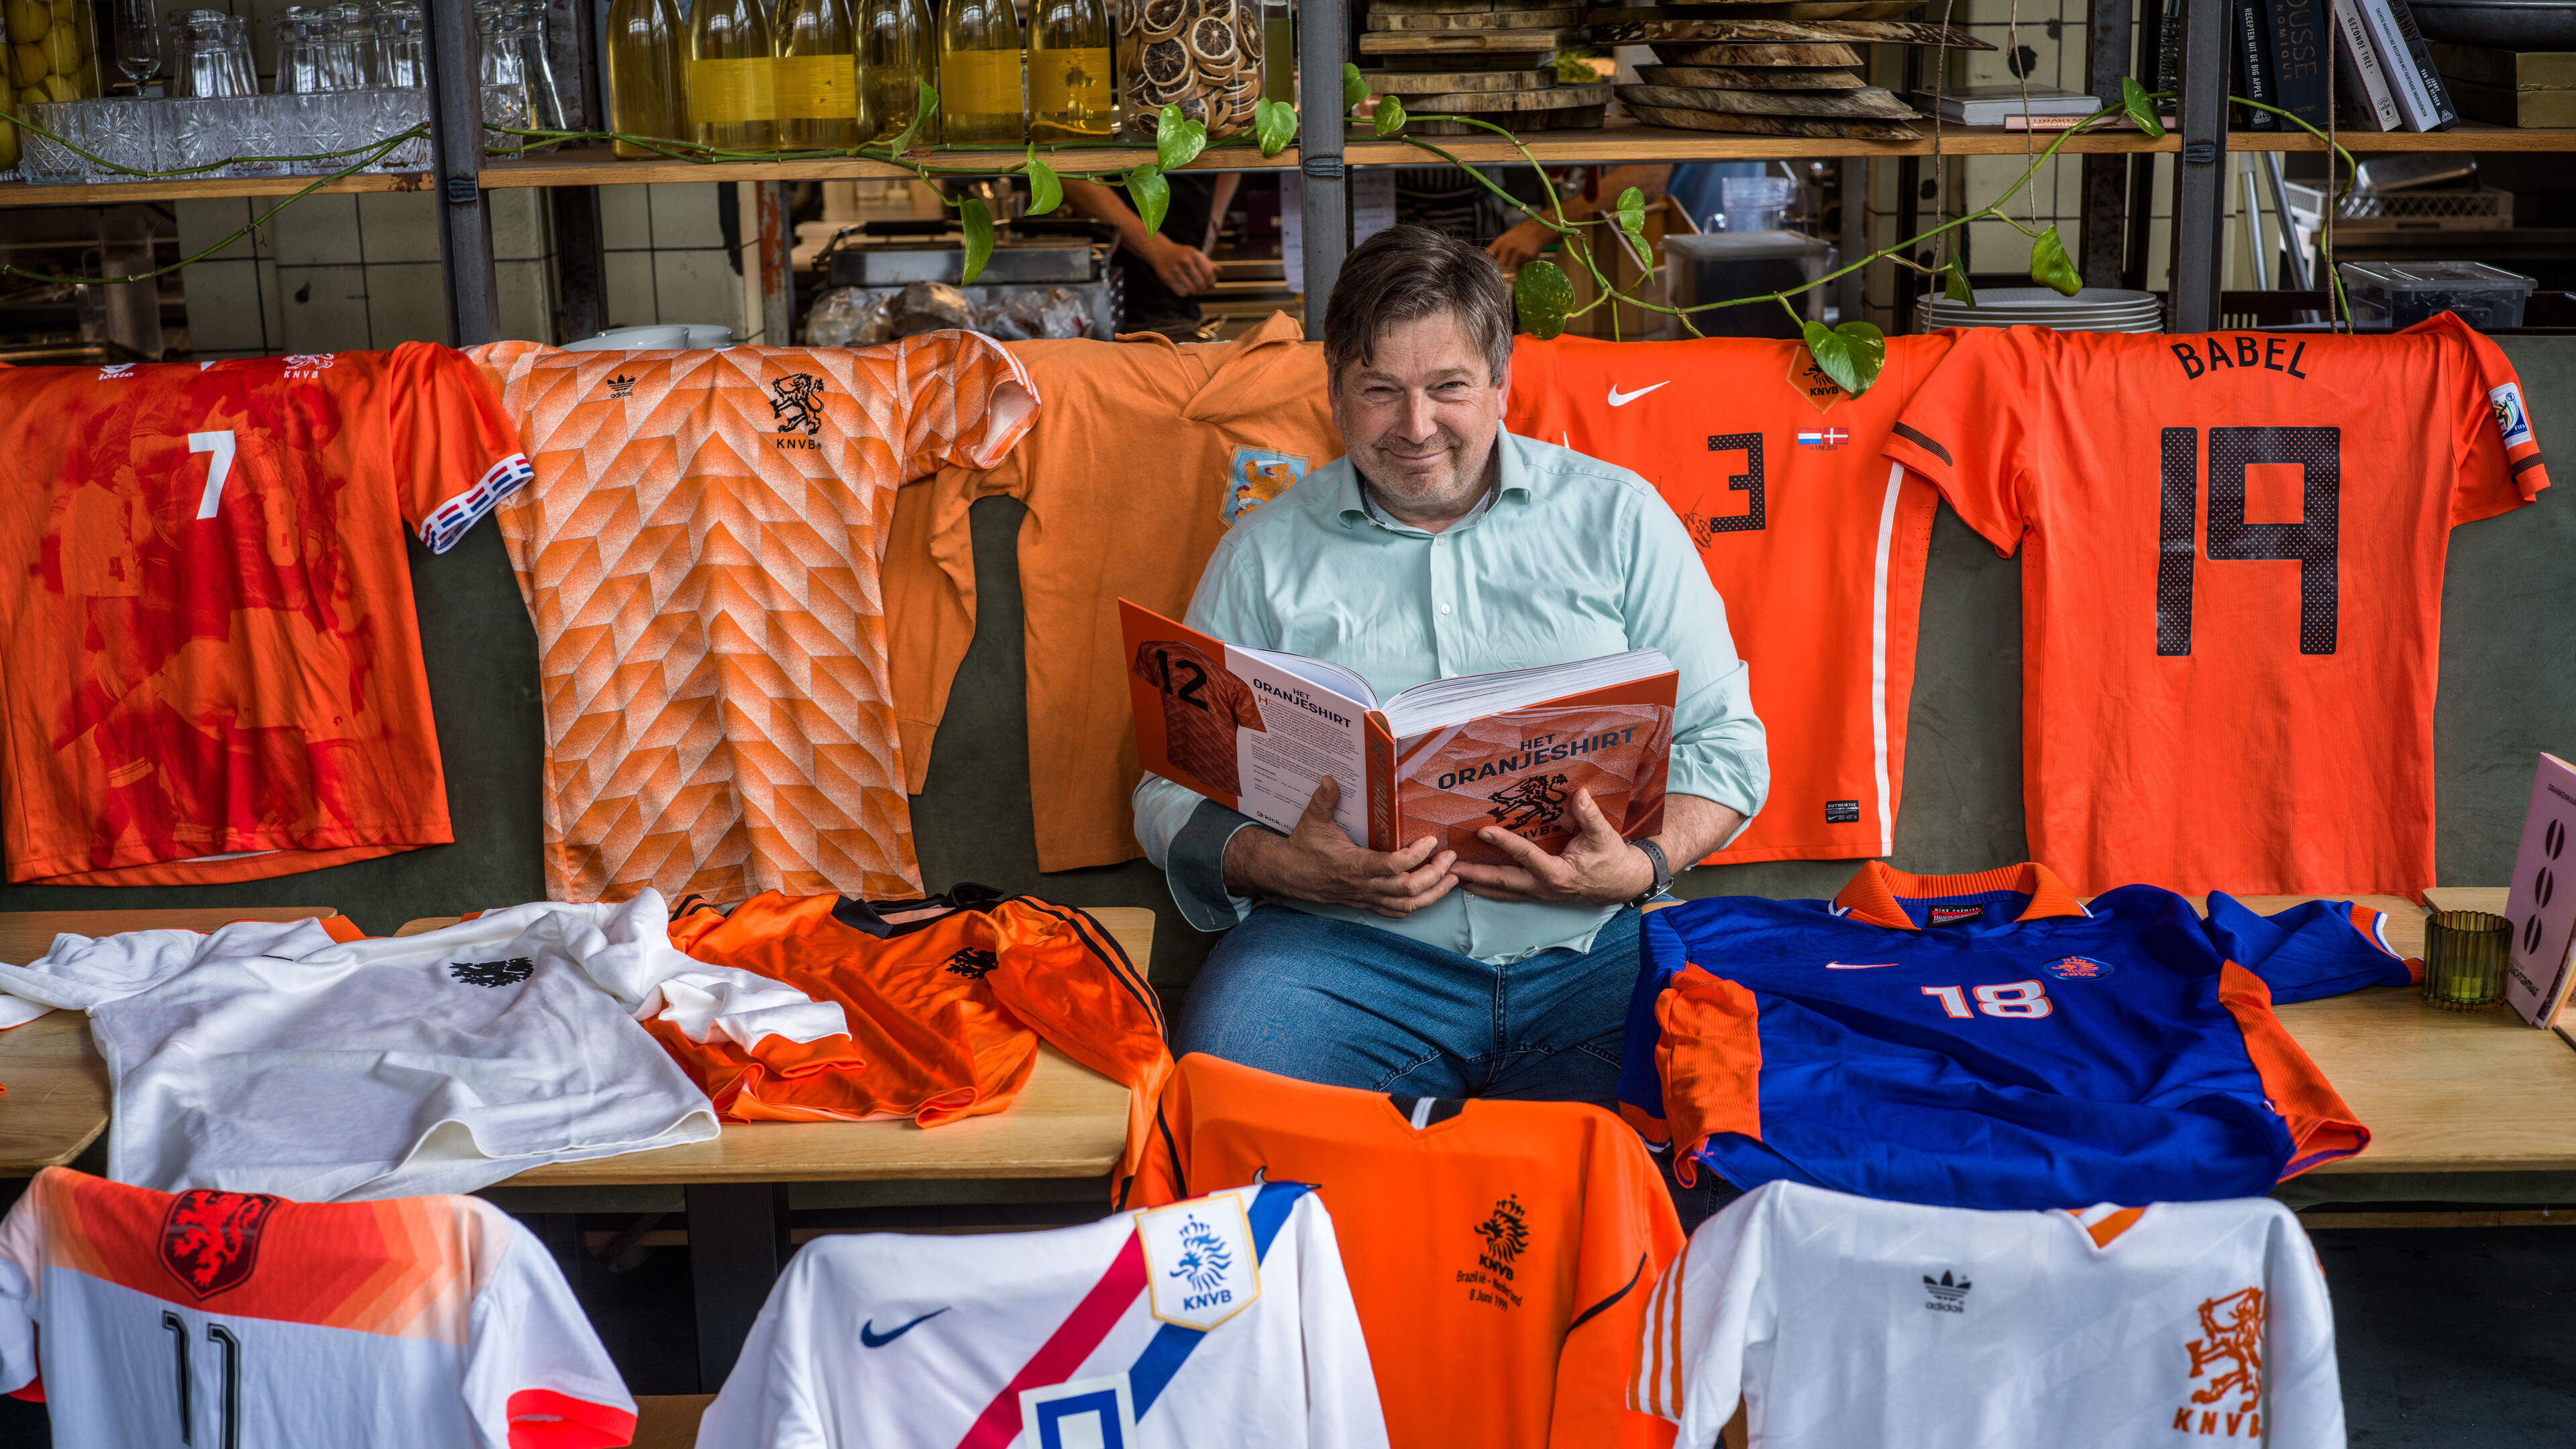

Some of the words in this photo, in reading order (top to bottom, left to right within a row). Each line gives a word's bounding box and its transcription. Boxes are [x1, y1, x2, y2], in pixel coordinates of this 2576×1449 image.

[2245, 7, 2255, 41] RECEPTEN
[2348, 17, 2365, 50] GEZONDE
[2361, 50, 2373, 70] THEE
[2250, 54, 2258, 64] DE
[2253, 77, 2262, 99] APPLE
[2425, 75, 2433, 89] DER
[2430, 76, 2440, 93] JANNY
[2169, 336, 2308, 380] BABEL
[98, 372, 134, 380] lotto
[284, 370, 319, 379] KNVB
[610, 389, 633, 398] adidas
[1810, 386, 1839, 396] KNVB
[776, 438, 816, 450] KNVB
[188, 430, 236, 519] 7
[1708, 432, 1766, 533] 3
[2156, 427, 2341, 657] 19
[1155, 649, 1208, 712] 12
[1253, 678, 1351, 728] ORANJESHIRT
[1293, 688, 1310, 700] HET
[1520, 733, 1556, 751] HET
[1438, 727, 1638, 790] ORANJESHIRT
[1921, 979, 2053, 1019] 18
[1479, 1254, 1513, 1281] KNVB
[1184, 1289, 1232, 1311] KNVB
[1925, 1300, 1964, 1313] adidas
[163, 1310, 241, 1449] 11
[2173, 1407, 2260, 1438] KNVB
